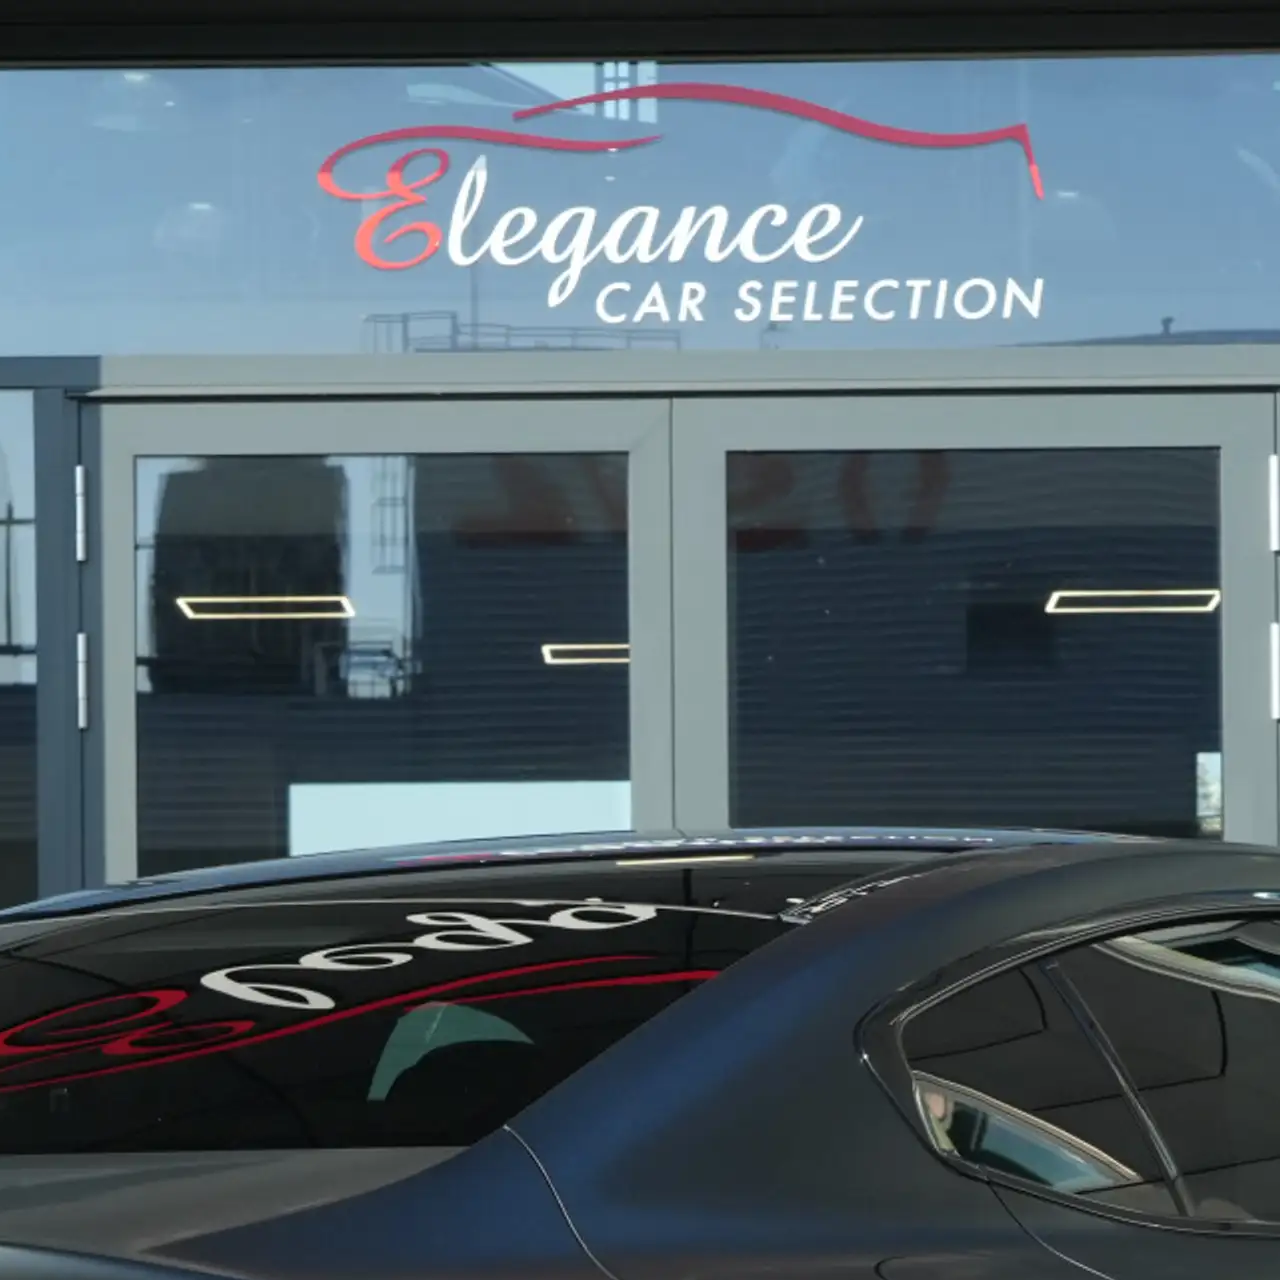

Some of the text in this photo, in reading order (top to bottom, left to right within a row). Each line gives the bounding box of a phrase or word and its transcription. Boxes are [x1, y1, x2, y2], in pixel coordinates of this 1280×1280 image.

[318, 145, 863, 308] Elegance
[594, 276, 1045, 324] CAR SELECTION
